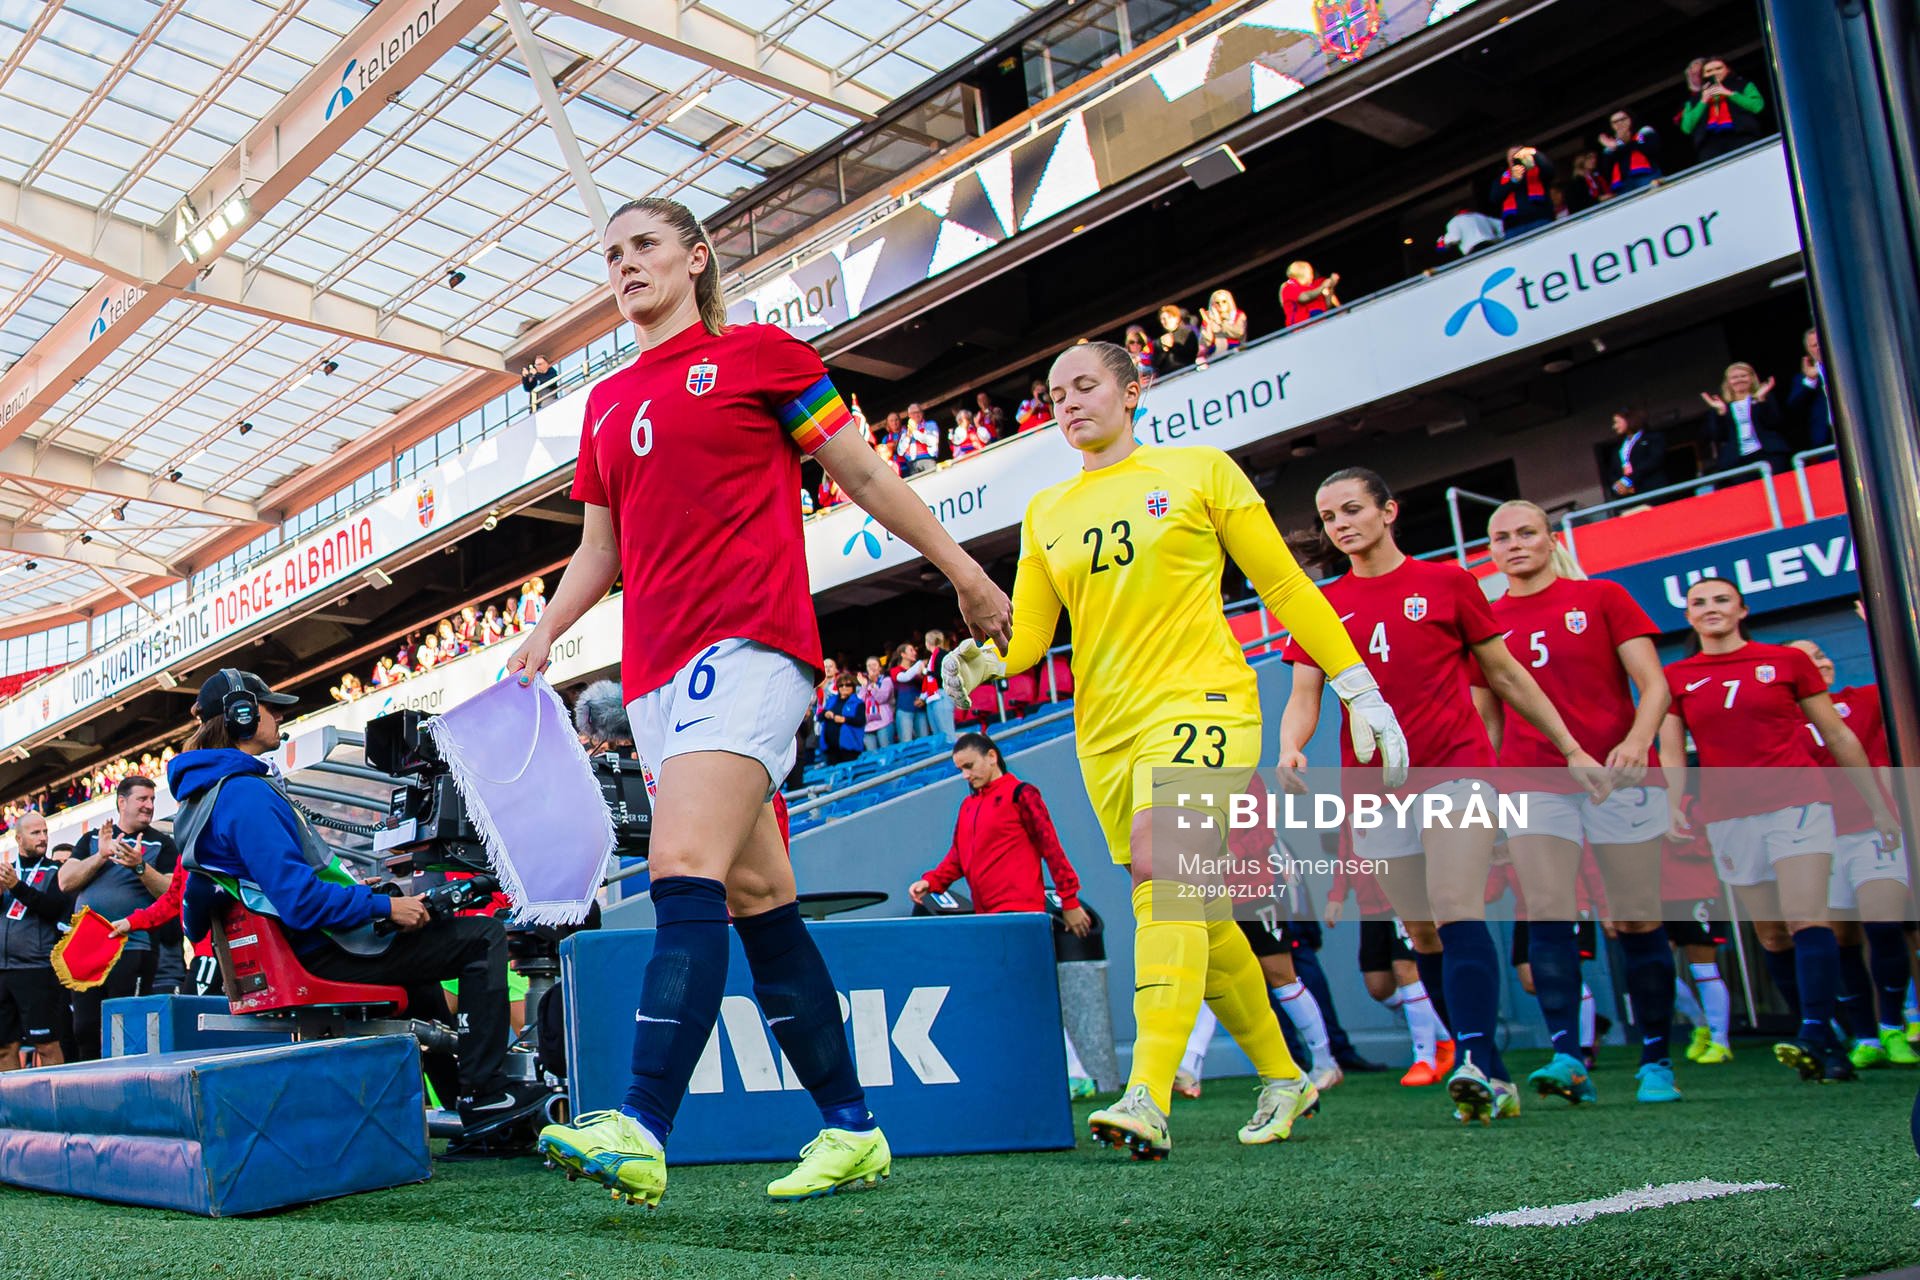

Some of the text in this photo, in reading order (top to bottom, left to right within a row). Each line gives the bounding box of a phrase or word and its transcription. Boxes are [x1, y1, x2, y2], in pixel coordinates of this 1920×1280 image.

[359, 0, 440, 91] telenor
[1516, 210, 1719, 310] telenor
[630, 399, 653, 457] 6
[1150, 371, 1291, 444] telenor
[1082, 519, 1135, 575] 23
[1663, 536, 1857, 609] ULEV
[215, 517, 373, 633] NORGE-ALBANIA
[1368, 622, 1390, 662] 4
[1530, 630, 1549, 668] 5
[688, 645, 721, 700] 6
[1722, 679, 1741, 709] 7
[1171, 723, 1227, 770] 23
[1804, 723, 1825, 748] 1
[196, 955, 217, 985] 11
